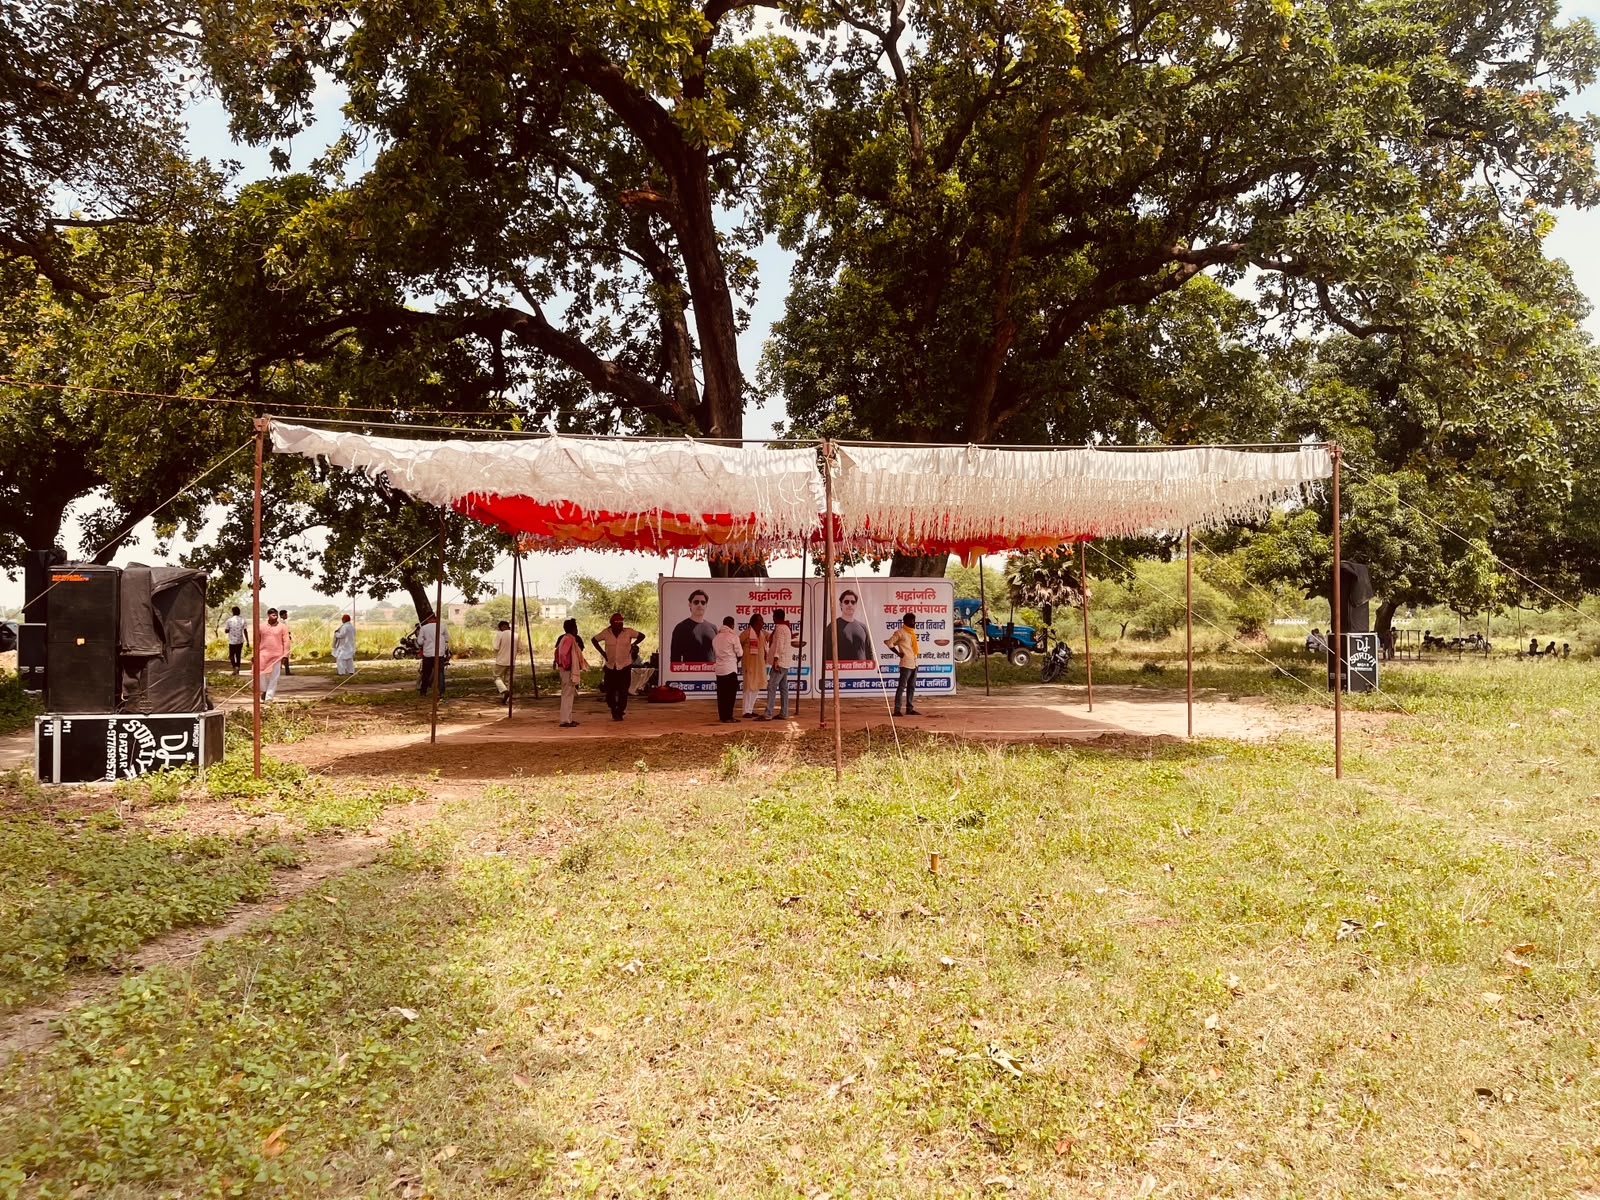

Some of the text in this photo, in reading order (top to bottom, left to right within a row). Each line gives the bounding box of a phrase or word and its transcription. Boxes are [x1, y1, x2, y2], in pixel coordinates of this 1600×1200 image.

[748, 588, 793, 602] श्रद्धांजलि
[895, 587, 937, 602] श्रद्धांजलि
[735, 605, 751, 615] सह
[883, 604, 898, 615] सह
[118, 732, 128, 768] BAZAR
